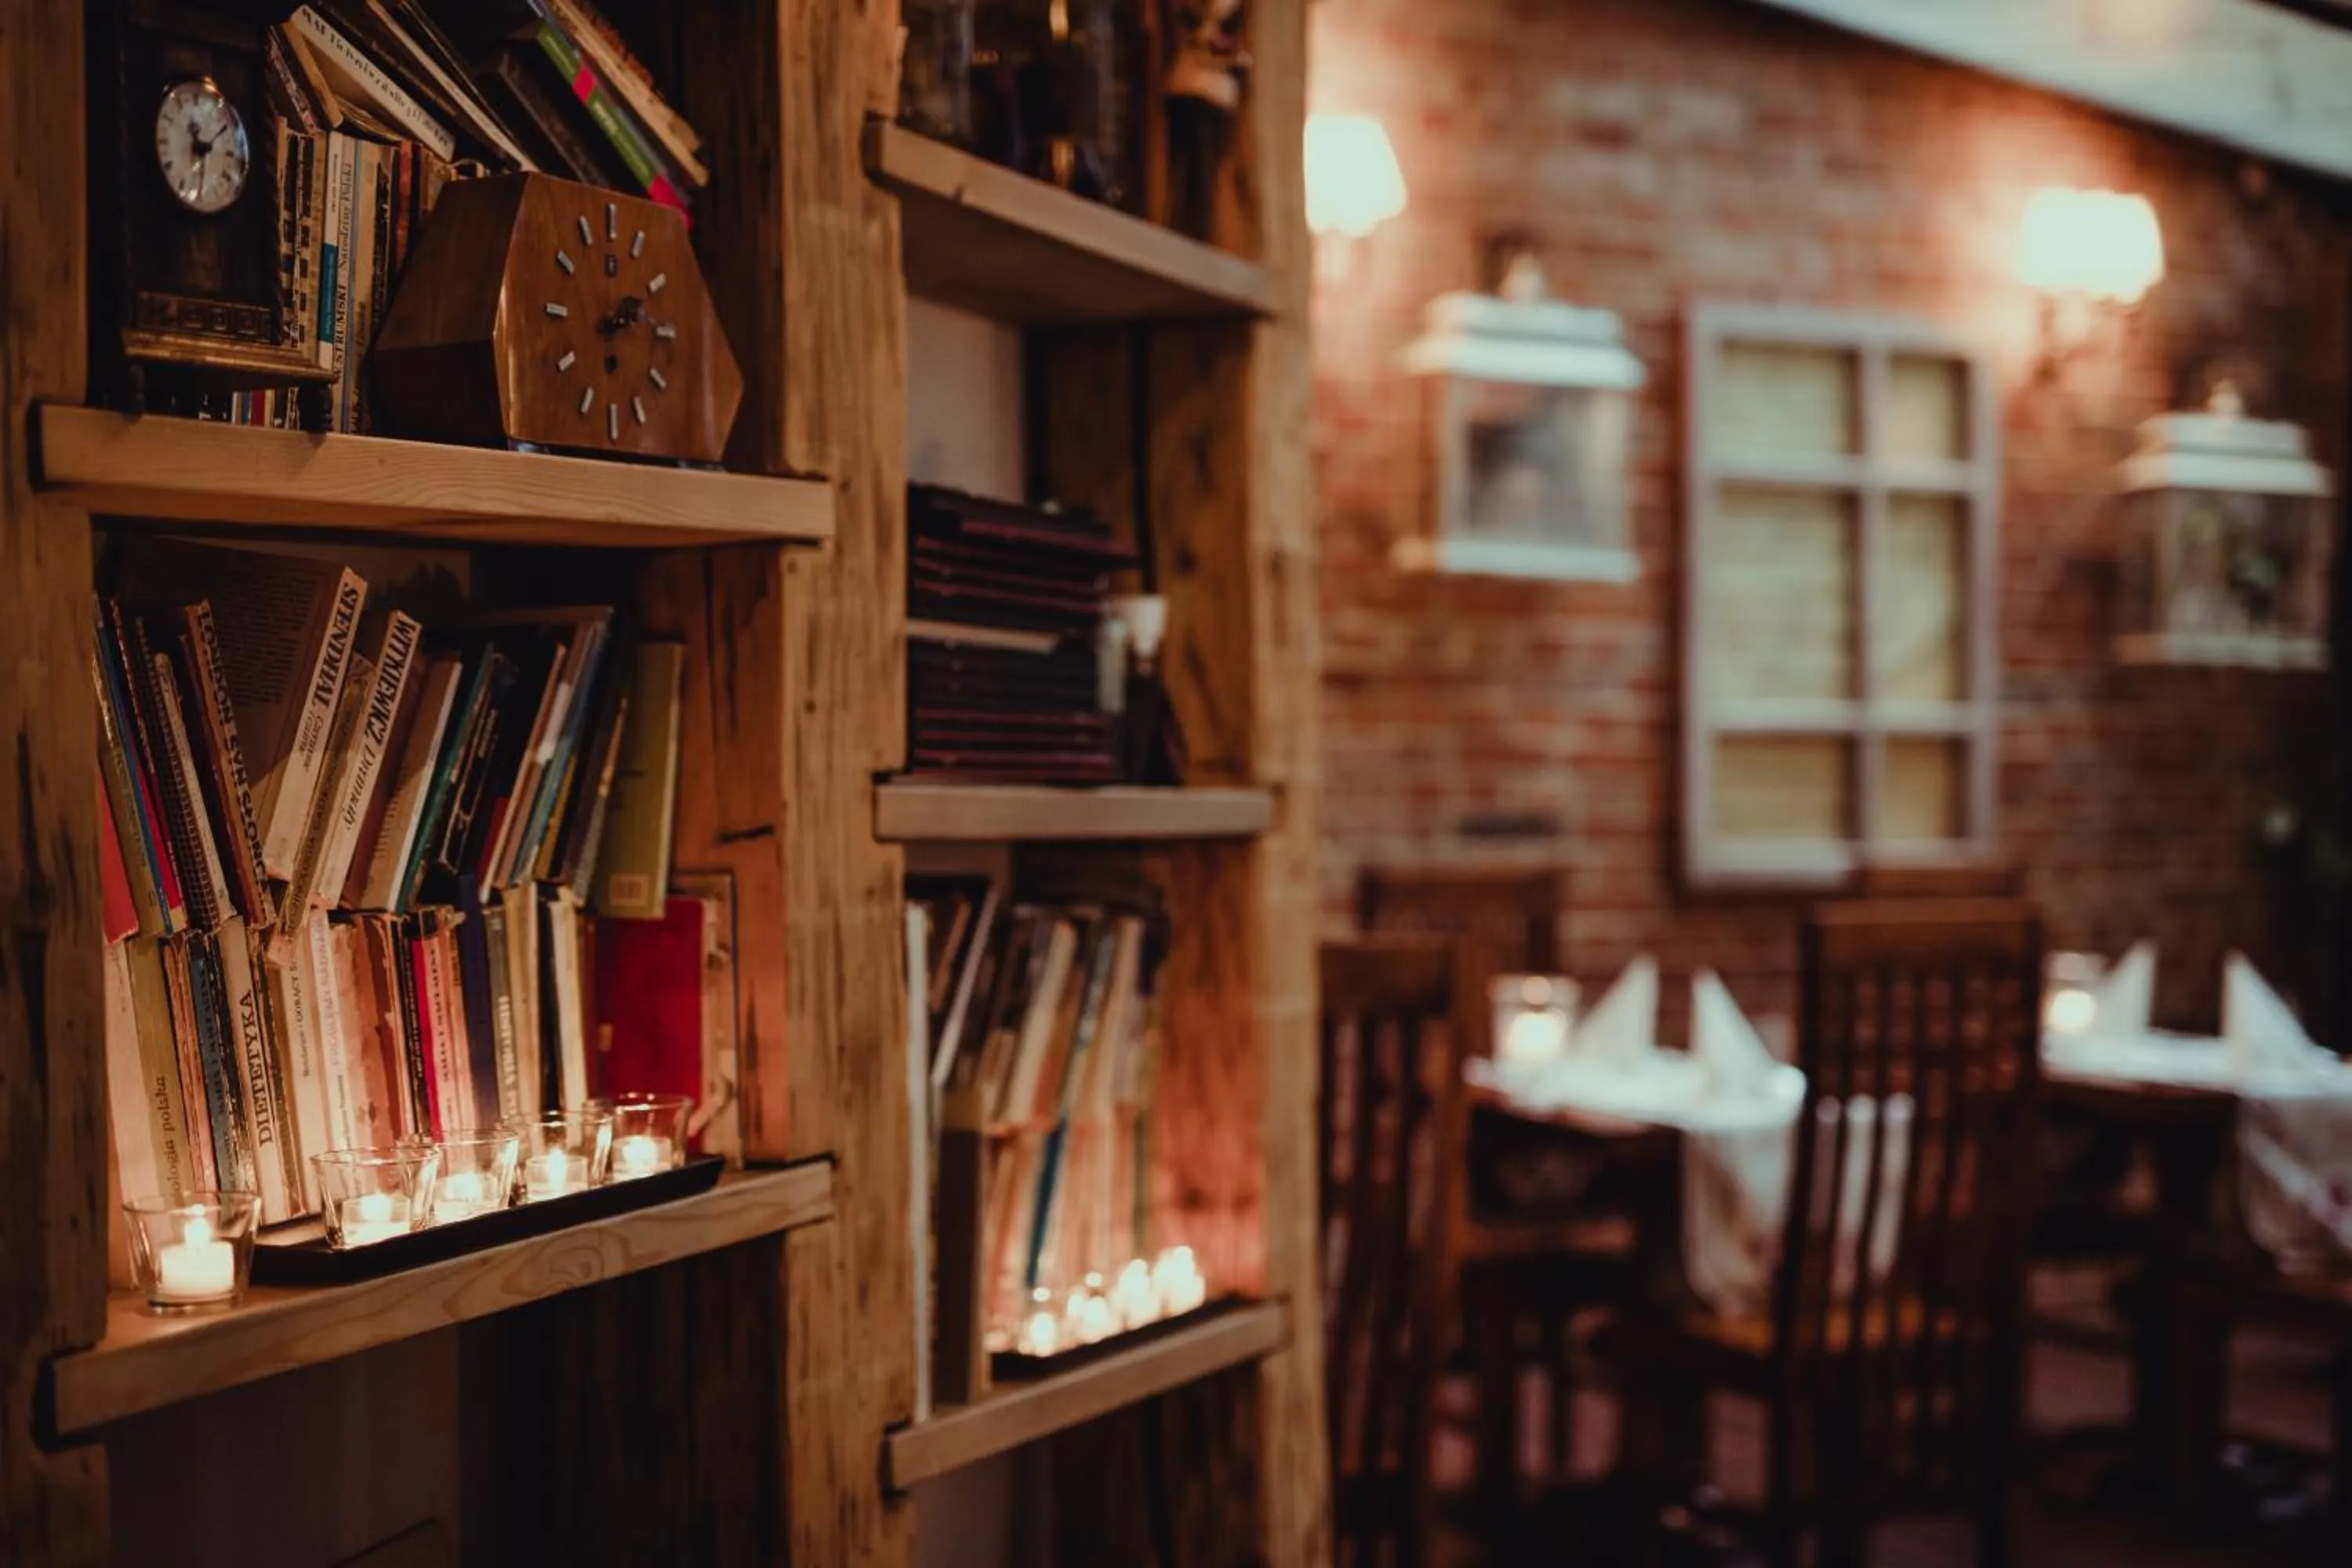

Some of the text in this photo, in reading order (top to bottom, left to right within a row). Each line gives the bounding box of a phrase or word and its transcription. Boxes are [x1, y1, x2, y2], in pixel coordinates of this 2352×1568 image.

[337, 206, 350, 268] Narodziny
[340, 162, 352, 202] Polski
[198, 610, 234, 724] LONDON
[312, 581, 358, 707] STENDHAL
[365, 616, 416, 746] WITKIEWICZ
[342, 743, 377, 831] Dramaty
[239, 989, 273, 1148] DIETETYKA
[155, 1076, 180, 1192] ologia polska
